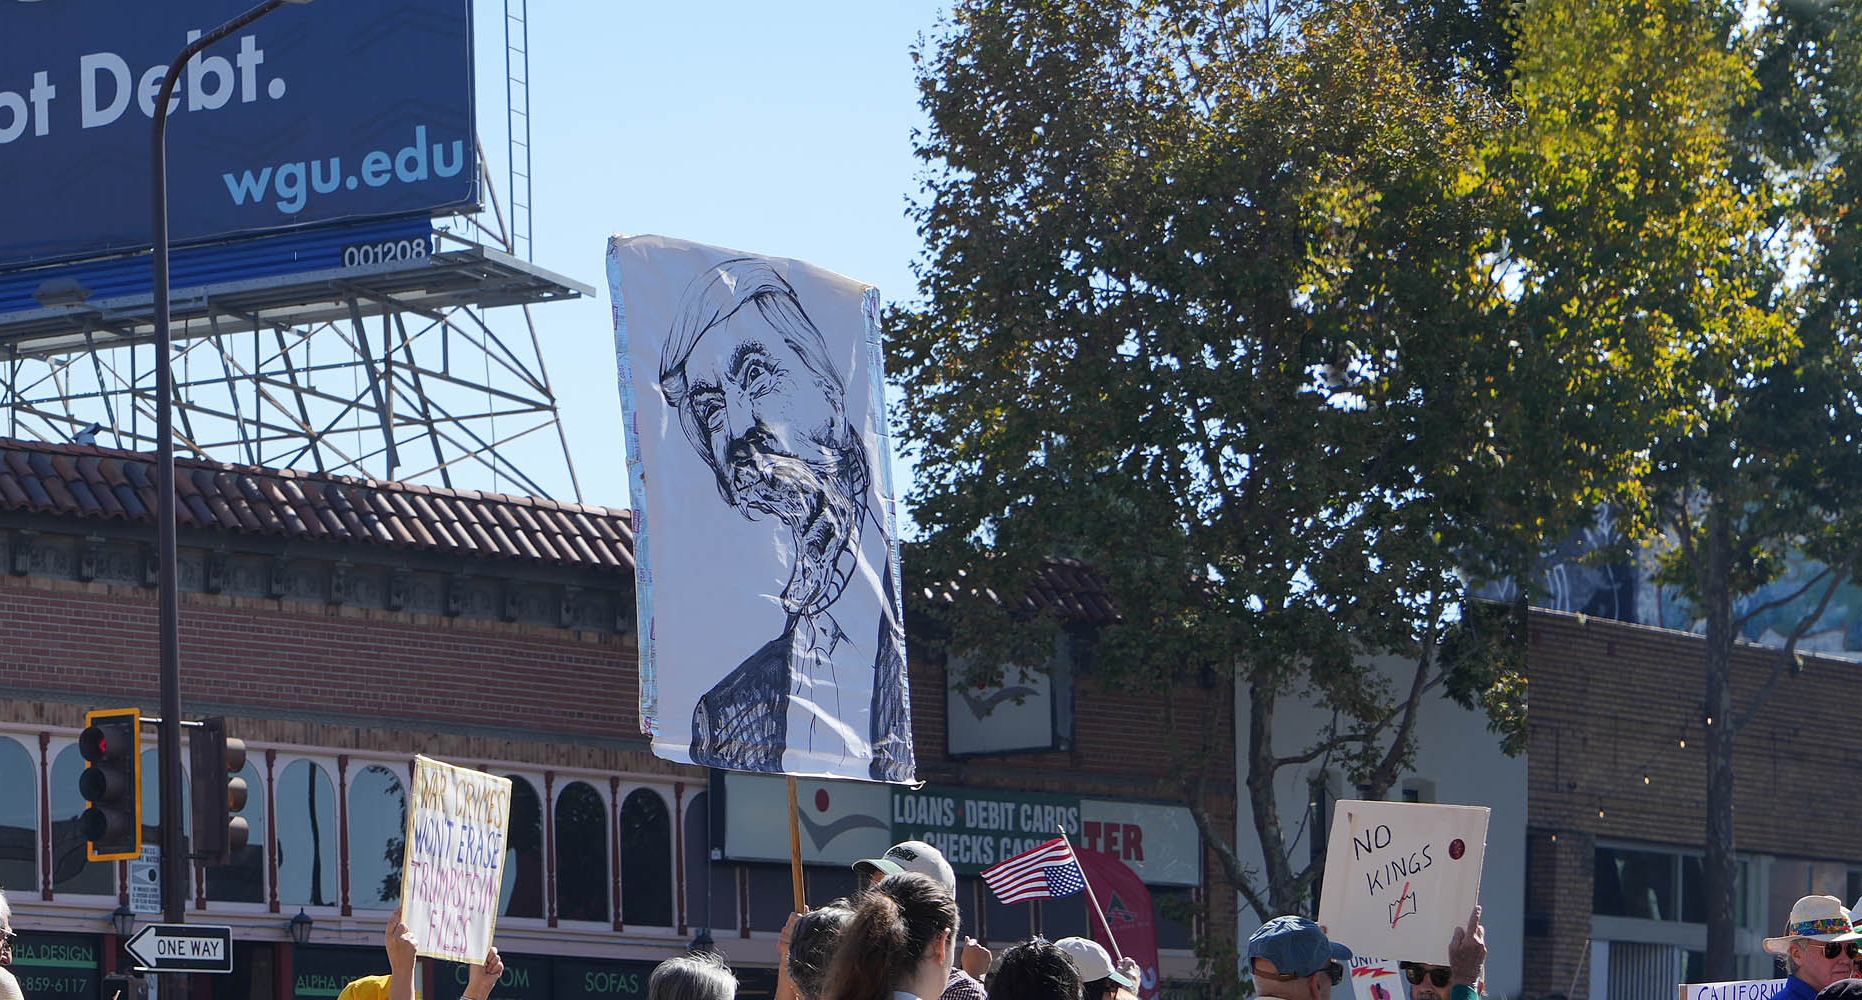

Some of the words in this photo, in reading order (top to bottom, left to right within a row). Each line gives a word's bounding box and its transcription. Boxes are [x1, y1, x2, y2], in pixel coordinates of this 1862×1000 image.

[80, 30, 286, 128] Debt.
[223, 125, 464, 214] wgu.edu
[343, 239, 426, 268] 001208
[419, 770, 447, 814] WAR
[455, 780, 506, 828] CRIMES
[894, 794, 955, 827] LOANS
[965, 800, 1015, 829] DEBIT
[1020, 803, 1079, 836] CARDS
[414, 815, 454, 858] WON'T
[457, 824, 503, 869] ERASE
[922, 831, 994, 866] CHECKS
[1353, 825, 1392, 861] NO
[410, 860, 497, 914] TRUMPSTEIN
[1366, 844, 1433, 896] KINGS
[157, 939, 185, 956] ONE
[190, 940, 220, 957] WAY
[427, 910, 471, 954] FILES
[43, 946, 93, 961] DESIGN
[296, 975, 337, 992] ALPHA
[585, 971, 638, 993] SOFAS
